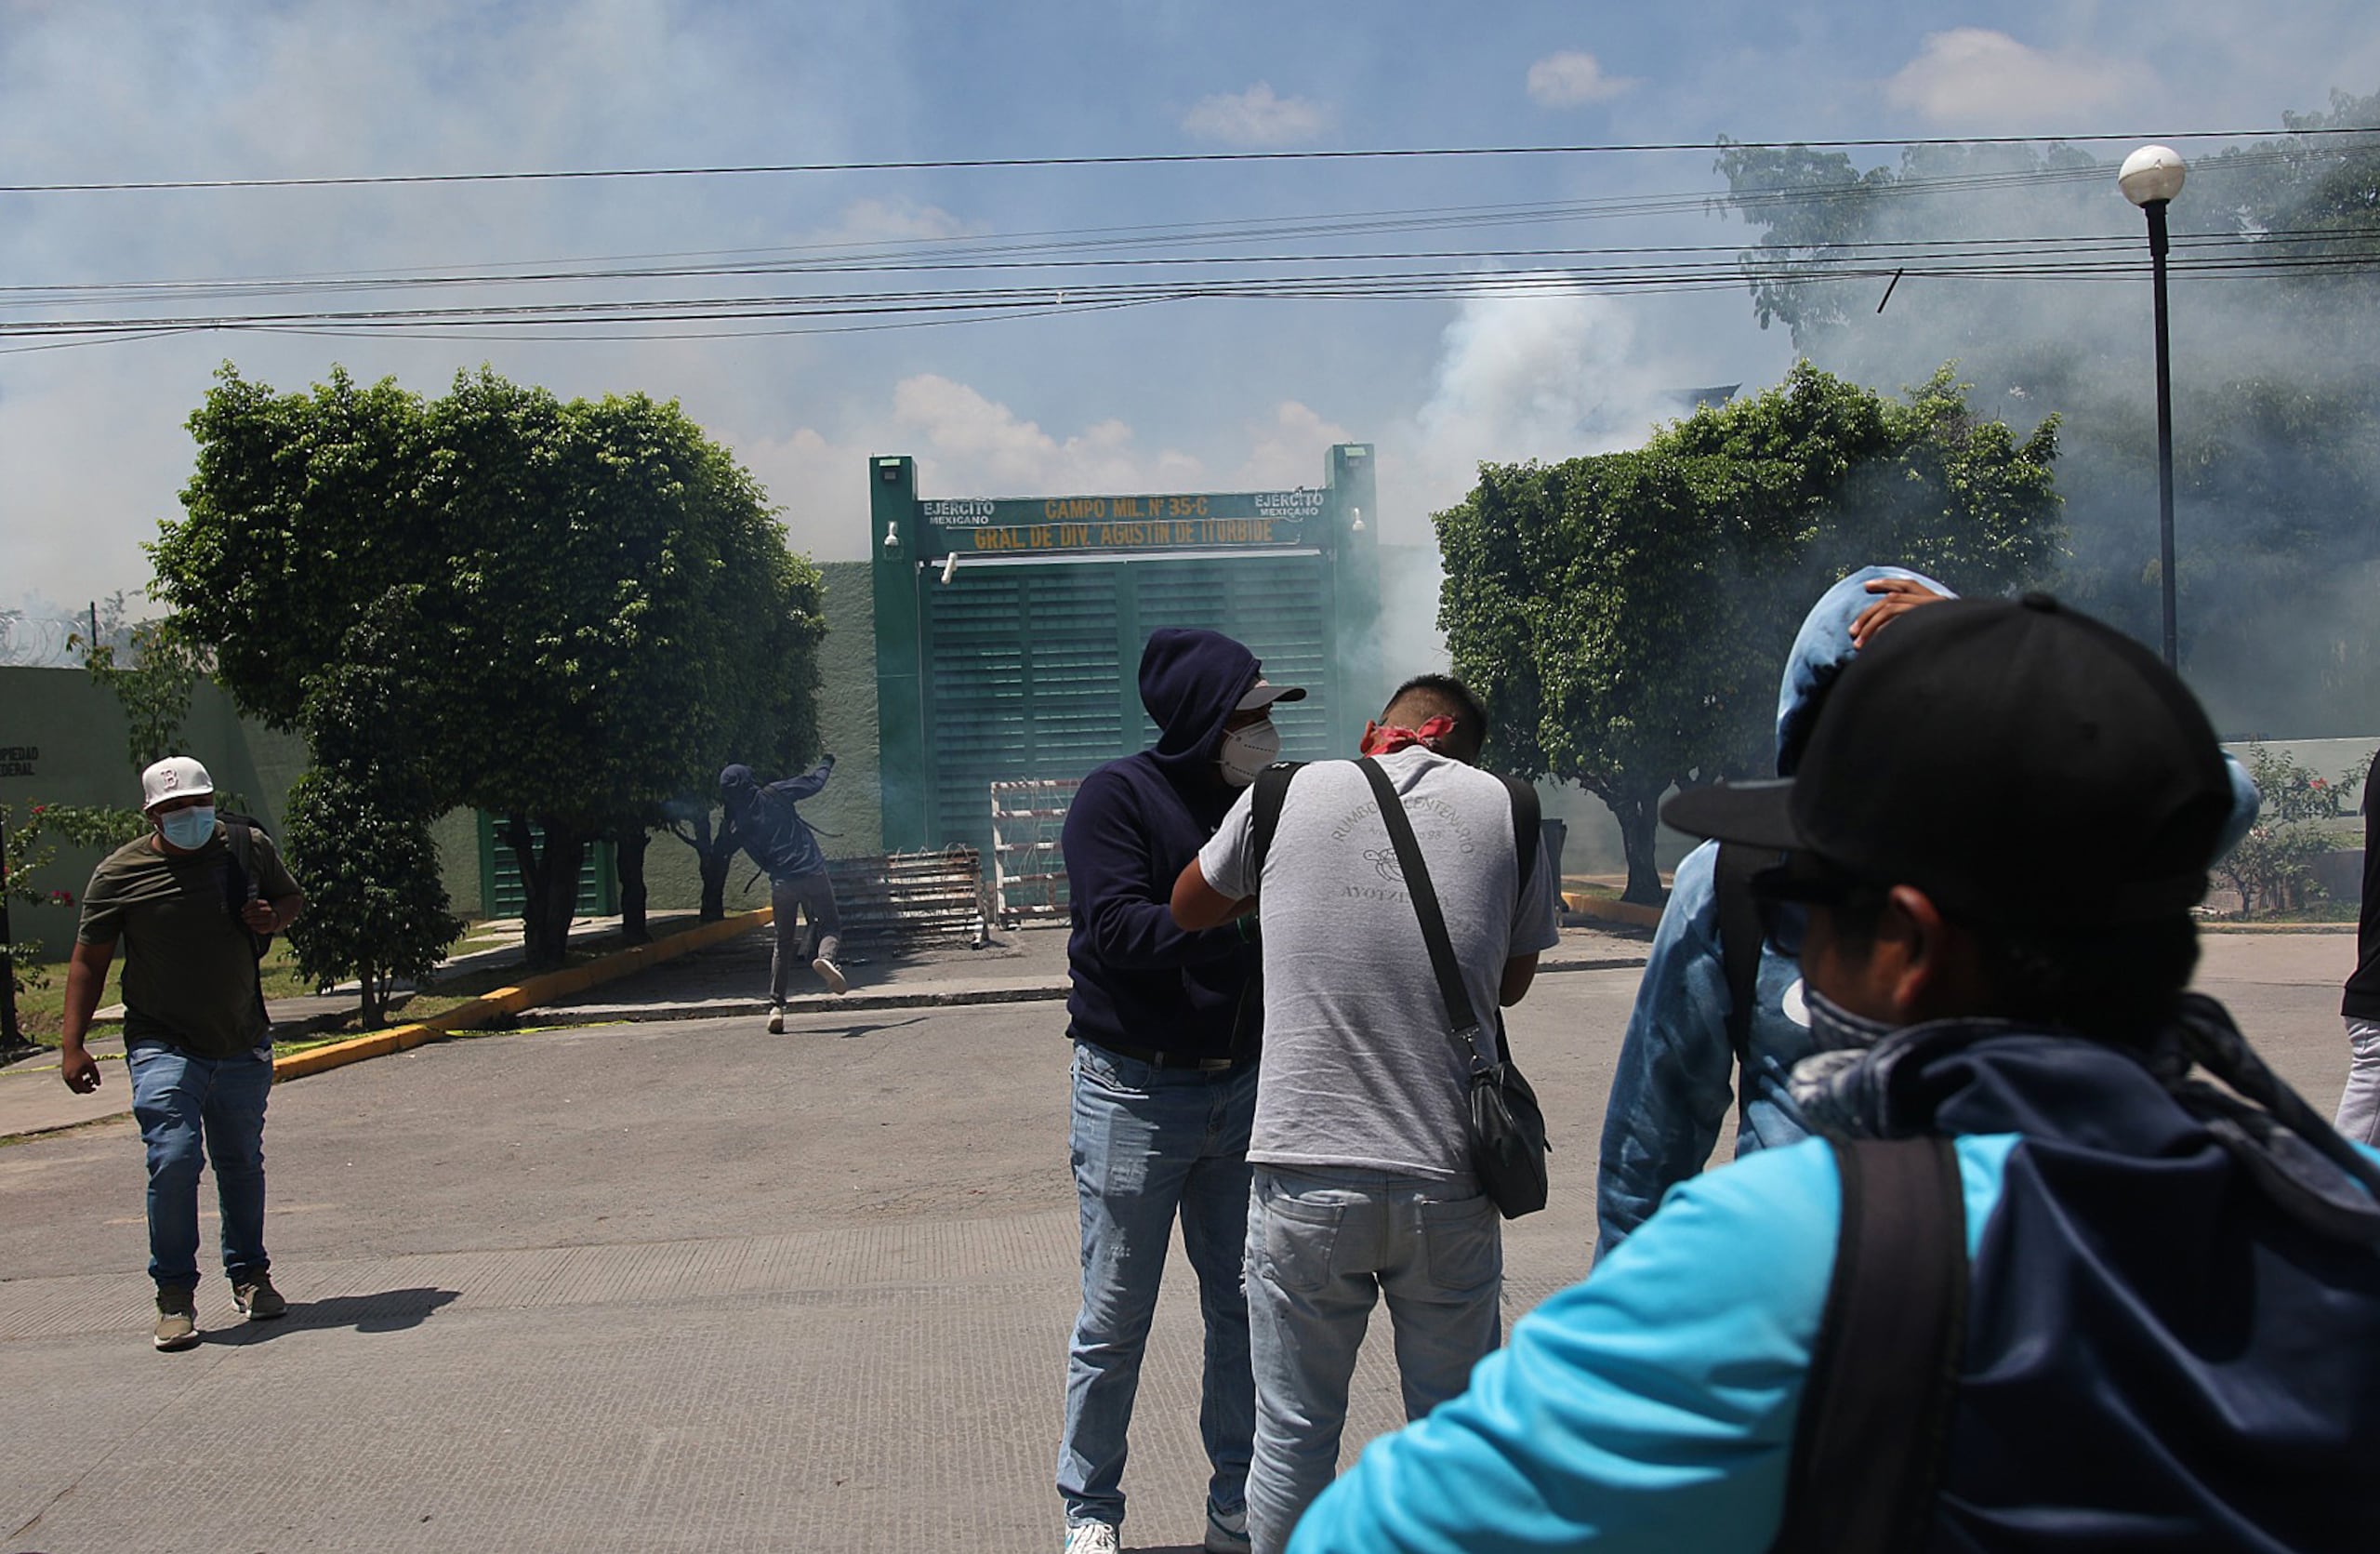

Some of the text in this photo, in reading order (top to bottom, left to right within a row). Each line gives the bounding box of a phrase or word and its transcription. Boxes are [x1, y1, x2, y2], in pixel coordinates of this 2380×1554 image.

[1044, 498, 1105, 520] CAMPO
[1113, 498, 1144, 518] MIL.
[1170, 496, 1208, 516] 35-C
[1260, 507, 1318, 516] MEXICANO
[930, 516, 990, 525] MEXICANO
[974, 527, 1026, 550] GRAL.
[1029, 525, 1052, 548] DE
[1061, 524, 1091, 547] DIV.
[1175, 521, 1195, 543] DE
[160, 768, 179, 792] B
[1331, 801, 1379, 842] RUMBO
